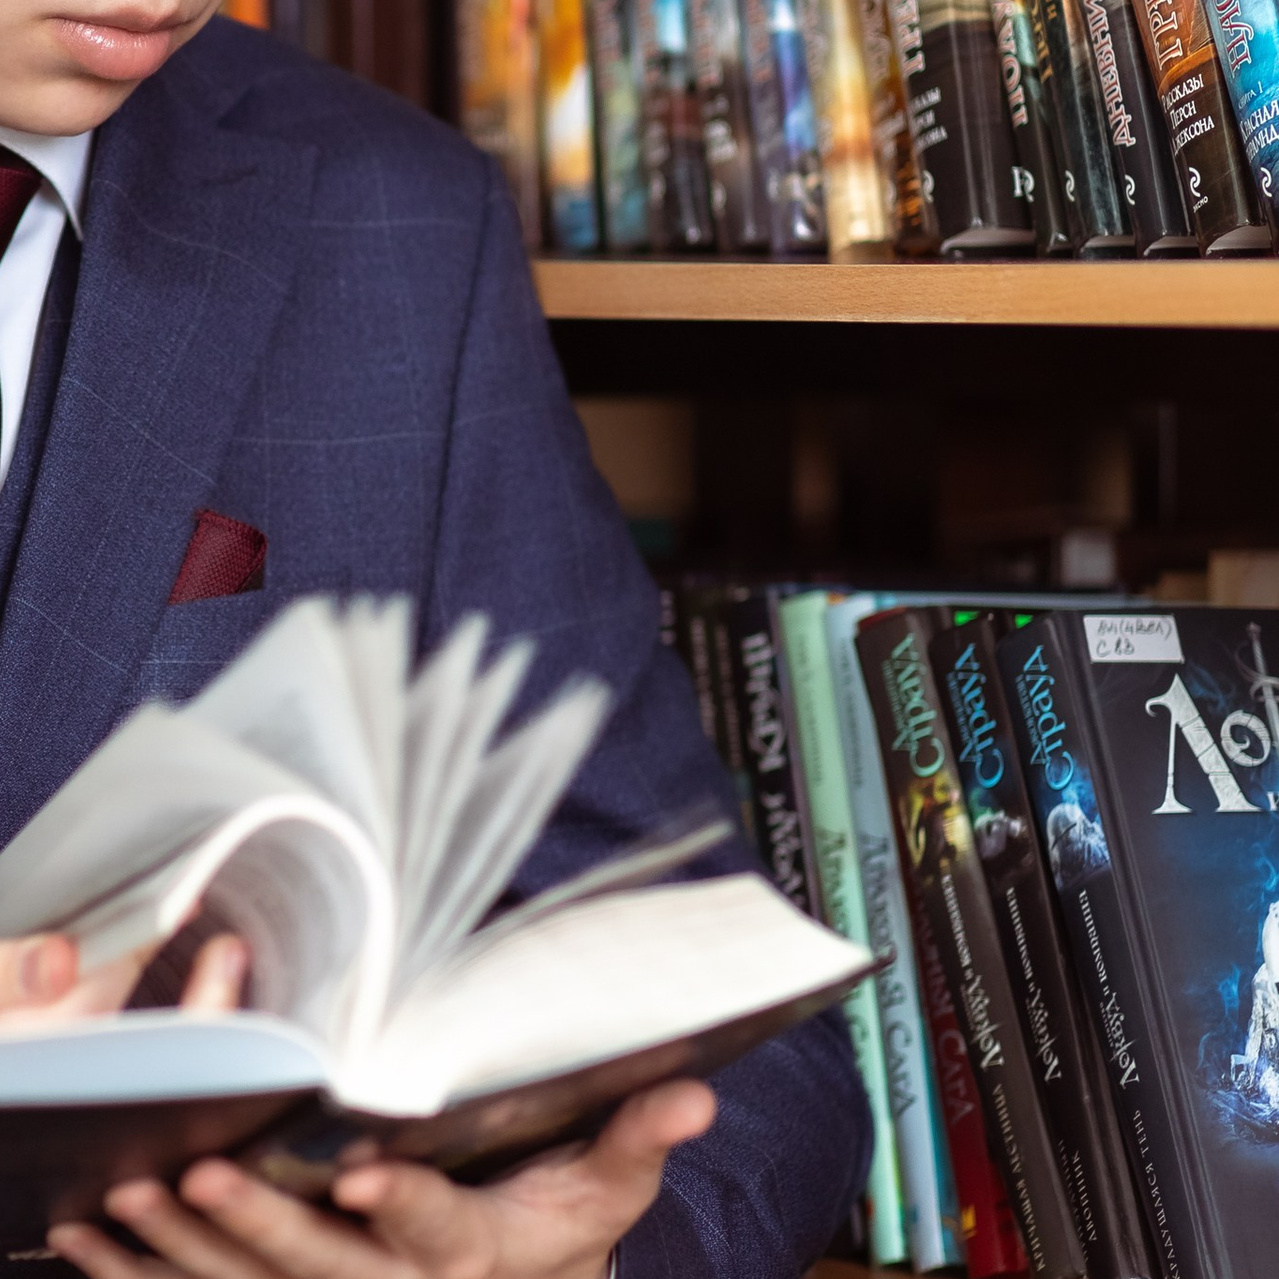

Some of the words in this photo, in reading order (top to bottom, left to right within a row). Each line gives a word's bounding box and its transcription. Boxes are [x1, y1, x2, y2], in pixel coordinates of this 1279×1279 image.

[1161, 74, 1205, 113] РАССКАЗЫ
[1169, 100, 1197, 129] ПЕРСИ
[1240, 99, 1279, 144] КРАСНАЯ
[1245, 123, 1279, 163] РАМИД
[1077, 888, 1108, 982] компания
[1131, 1108, 1151, 1158] ТЕНЬ
